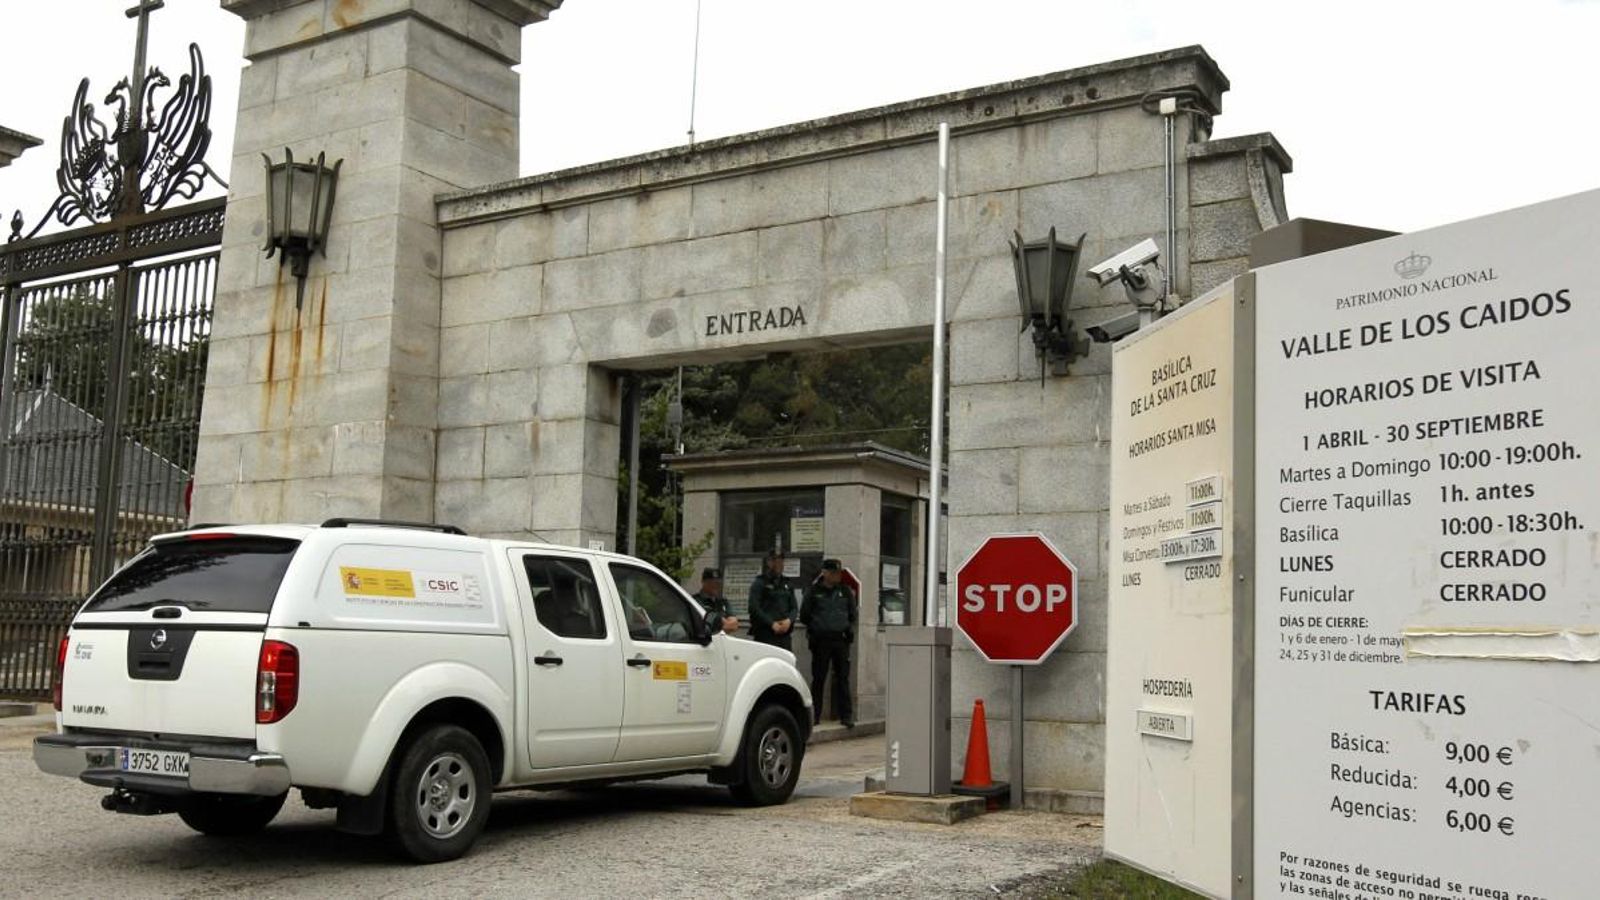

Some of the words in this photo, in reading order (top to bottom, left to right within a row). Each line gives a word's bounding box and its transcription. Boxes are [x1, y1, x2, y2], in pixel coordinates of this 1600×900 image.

[1336, 284, 1417, 310] PATRIMONIO
[1421, 268, 1498, 293] NACIONAL
[706, 306, 808, 336] ENTRADA
[1282, 328, 1351, 359] VALLE
[1360, 321, 1392, 346] DE
[1402, 311, 1450, 340] LOS
[1460, 289, 1571, 329] CAIDOS
[1152, 355, 1192, 386] BASÍLICA
[1306, 378, 1414, 409] HORARIOS
[1423, 372, 1452, 394] DE
[1460, 360, 1540, 389] VISITA
[1131, 398, 1142, 416] DE
[1144, 394, 1154, 412] LA
[1158, 380, 1188, 406] SANTA
[1191, 368, 1216, 392] CRUZ
[1130, 431, 1165, 458] HORARIOS
[1168, 424, 1194, 445] SANTA
[1196, 418, 1216, 436] MISA
[1303, 436, 1308, 450] 1
[1318, 429, 1368, 450] ABRIL
[1387, 424, 1409, 442] 30
[1416, 410, 1544, 440] SEPTIEMBRE
[1280, 466, 1331, 484] Martes
[1337, 467, 1346, 478] a
[1352, 456, 1430, 478] Domingo
[1439, 450, 1491, 470] 10:00
[1506, 442, 1582, 465] 19:00h.
[1280, 497, 1327, 513] Cierre
[1334, 490, 1411, 511] Taquillas
[1476, 484, 1534, 500] antes
[1280, 526, 1338, 542] Basílica
[1441, 516, 1492, 535] 10:00
[1508, 511, 1584, 532] 18:30h.
[1122, 572, 1141, 586] LUNES
[1184, 564, 1220, 580] CERRADO
[1280, 556, 1334, 572] LUNES
[1440, 548, 1546, 568] CERRADO
[963, 584, 1066, 612] STOP
[1280, 586, 1354, 602] Funicular
[1440, 582, 1546, 602] CERRADO
[1308, 617, 1322, 628] DE
[1326, 617, 1368, 628] CIERRE:
[1280, 648, 1294, 660] 24,
[1298, 650, 1308, 660] 25
[1312, 652, 1318, 662] y
[1320, 650, 1330, 661] 31
[1334, 650, 1346, 662] de
[1288, 636, 1294, 644] y
[1296, 633, 1302, 644] 6
[1306, 633, 1317, 644] de
[1320, 636, 1348, 644] enero
[1363, 634, 1376, 646] de
[1143, 678, 1193, 698] HOSPEDERÍA
[1370, 690, 1466, 715] TARIFAS
[132, 752, 159, 771] 3752
[164, 754, 186, 773] GXK
[1331, 732, 1390, 754] Básica:
[1446, 742, 1490, 764] 9,00
[1496, 746, 1513, 766] €
[1331, 764, 1418, 789] Reducida:
[1446, 776, 1490, 798] 4,00
[1496, 782, 1514, 801] €
[1331, 796, 1416, 822] Agencias:
[1446, 810, 1491, 832] 6,00
[1497, 816, 1514, 836] €
[1280, 852, 1298, 864] Por
[1304, 857, 1350, 873] razones
[1355, 864, 1370, 876] de
[1376, 869, 1440, 889] seguridad
[1448, 881, 1462, 892] se
[1280, 865, 1295, 878] las
[1300, 870, 1332, 884] zonas
[1336, 876, 1350, 888] de
[1354, 880, 1394, 896] acceso
[1399, 889, 1414, 900] no
[1280, 882, 1286, 892] y
[1290, 881, 1304, 894] las
